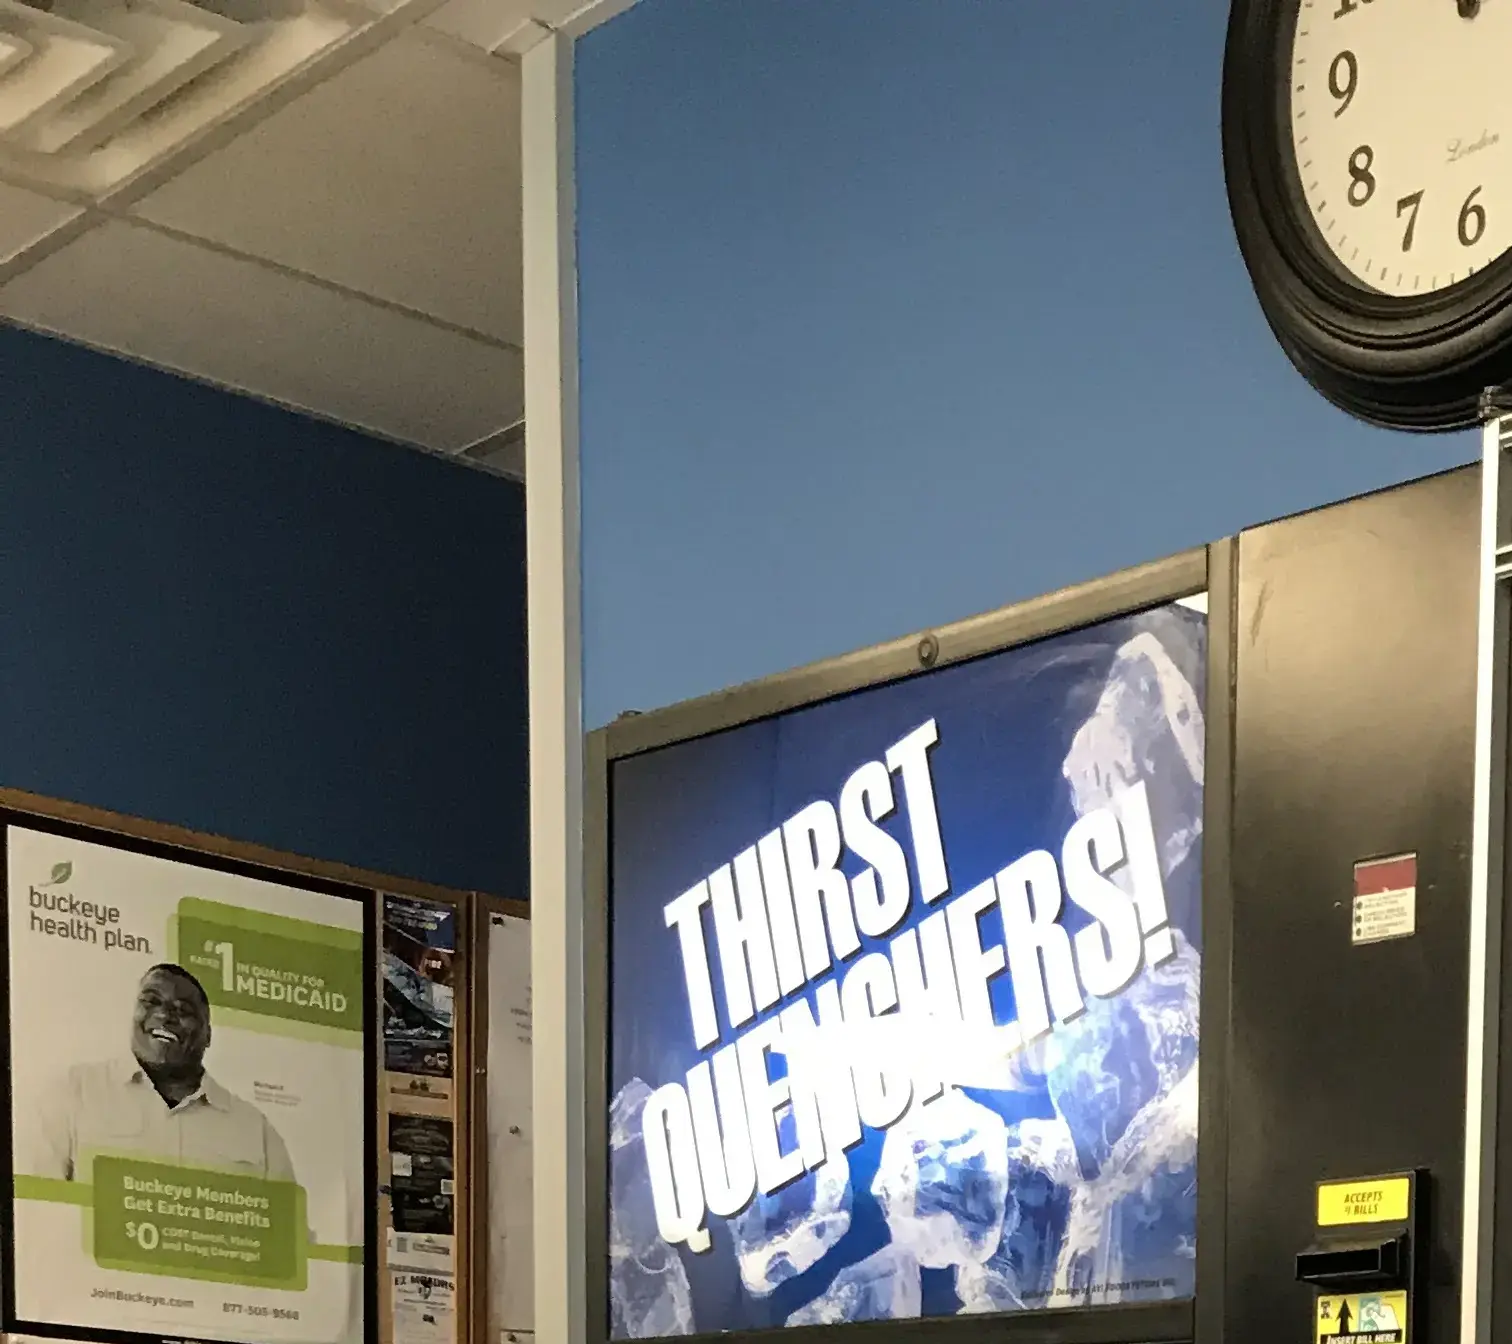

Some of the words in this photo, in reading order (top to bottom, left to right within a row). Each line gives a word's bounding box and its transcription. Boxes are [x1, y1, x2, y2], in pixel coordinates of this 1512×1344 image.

[1329, 50, 1358, 118] 9
[1348, 144, 1376, 207] 8
[1396, 189, 1424, 252] 7
[1458, 186, 1486, 247] 6
[664, 717, 951, 1051] THIRST
[28, 886, 120, 925] buckeye
[30, 910, 97, 944] health
[236, 962, 249, 974] IN
[252, 965, 300, 983] QUALITY
[302, 975, 325, 988] FOR
[236, 975, 347, 1013] MEDICAID
[642, 780, 1178, 1254] QUENCHERS!
[123, 1176, 192, 1200] Buckeye
[196, 1186, 269, 1210] Members
[1344, 1191, 1383, 1204] ACCEPTS
[1353, 1203, 1378, 1215] BILLS
[124, 1196, 153, 1213] Get
[157, 1200, 200, 1220] Extra
[204, 1206, 271, 1228] Benefits
[125, 1221, 159, 1250] $0
[1356, 1333, 1373, 1344] BILL
[1375, 1332, 1396, 1343] HERE
